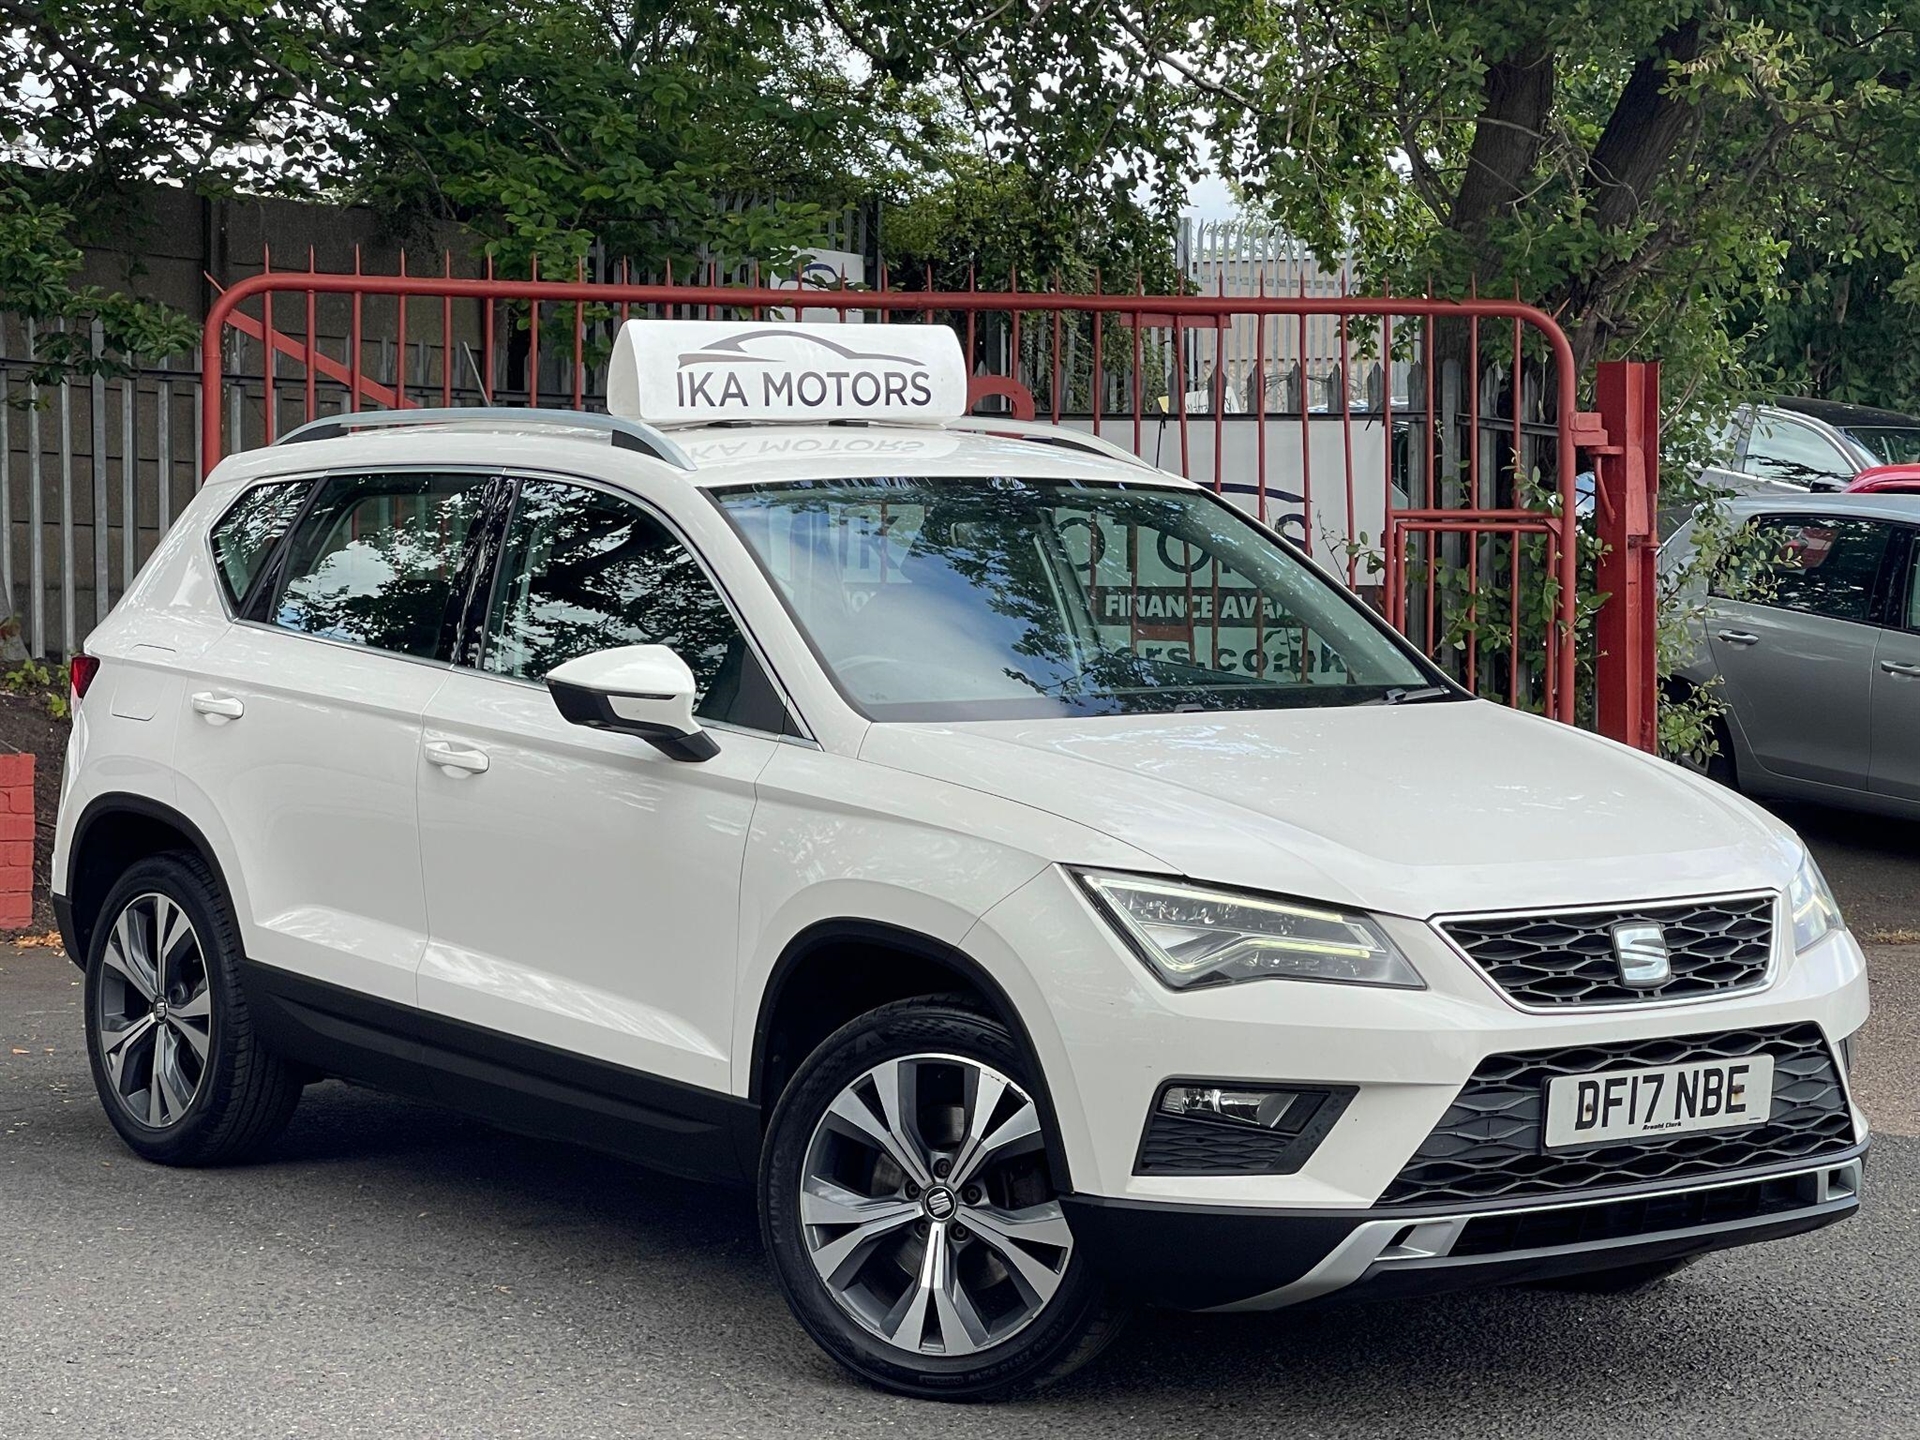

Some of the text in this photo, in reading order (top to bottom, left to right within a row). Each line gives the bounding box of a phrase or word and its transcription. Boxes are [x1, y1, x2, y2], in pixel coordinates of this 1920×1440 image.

[677, 371, 932, 408] IKA MOTORS
[1105, 595, 1212, 619] FINANCE
[1574, 1065, 1750, 1131] DF17 NBE
